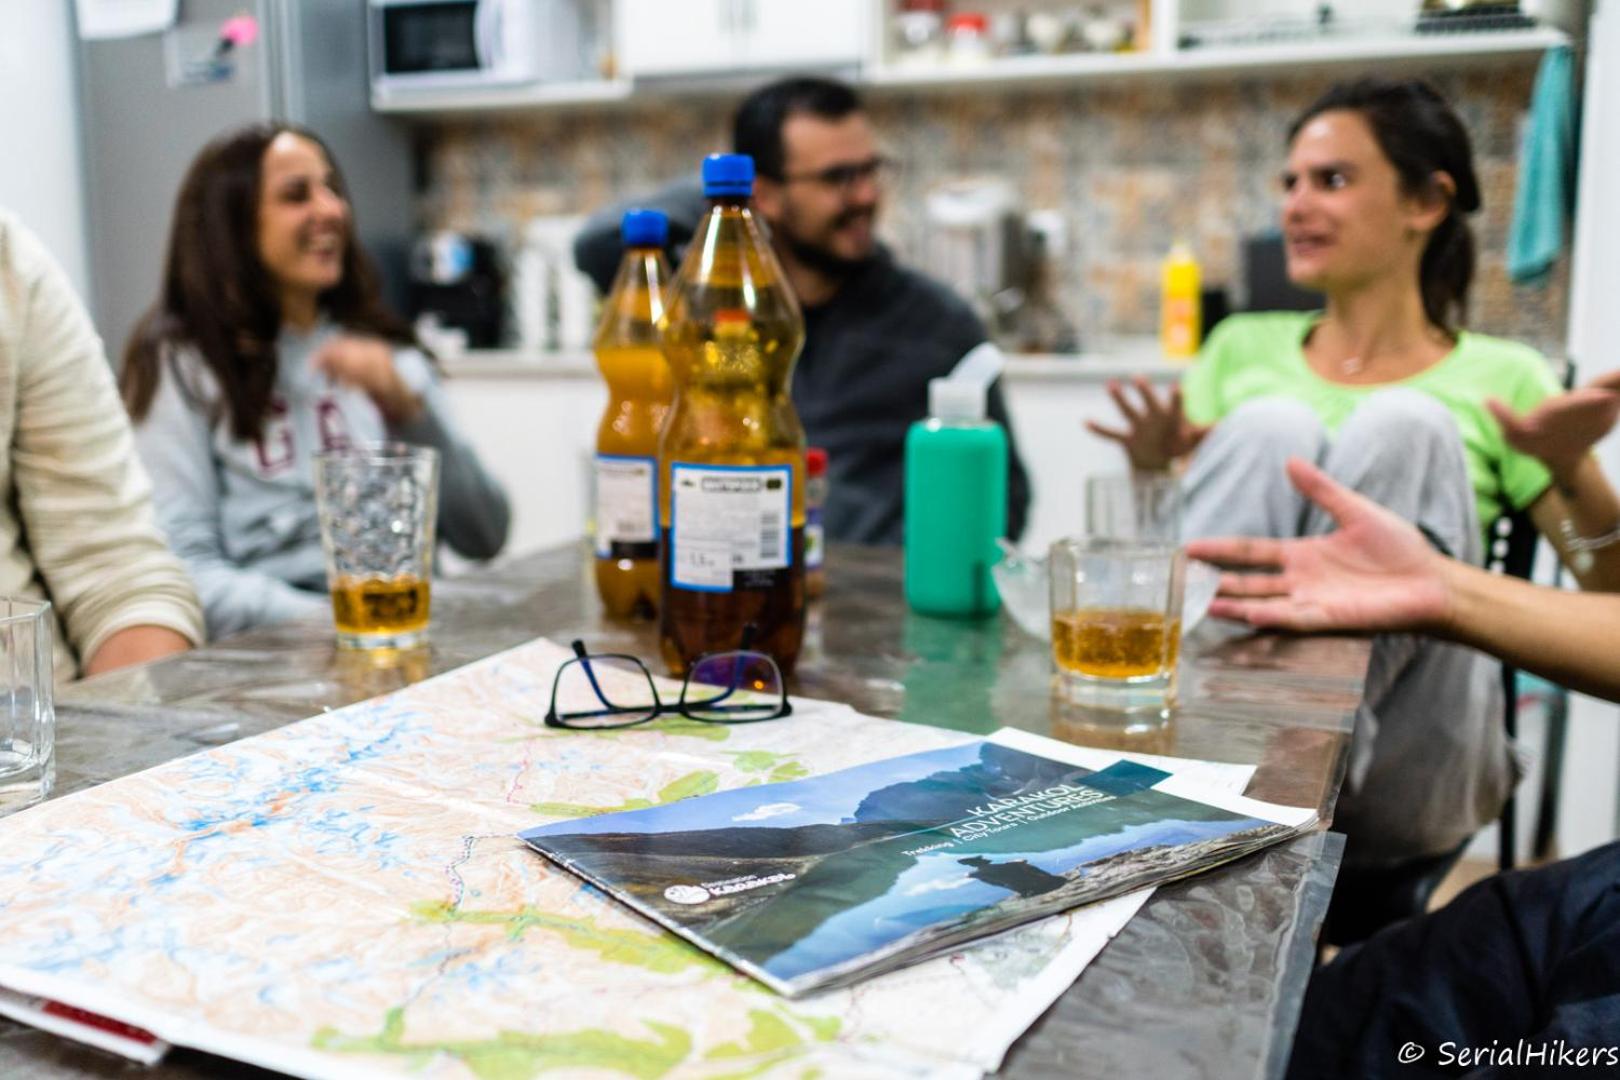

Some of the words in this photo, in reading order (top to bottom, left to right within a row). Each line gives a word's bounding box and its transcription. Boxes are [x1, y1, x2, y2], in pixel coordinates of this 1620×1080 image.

[950, 789, 1105, 838] ADVENTURES
[966, 783, 1088, 818] KARAKOL
[962, 828, 989, 842] City
